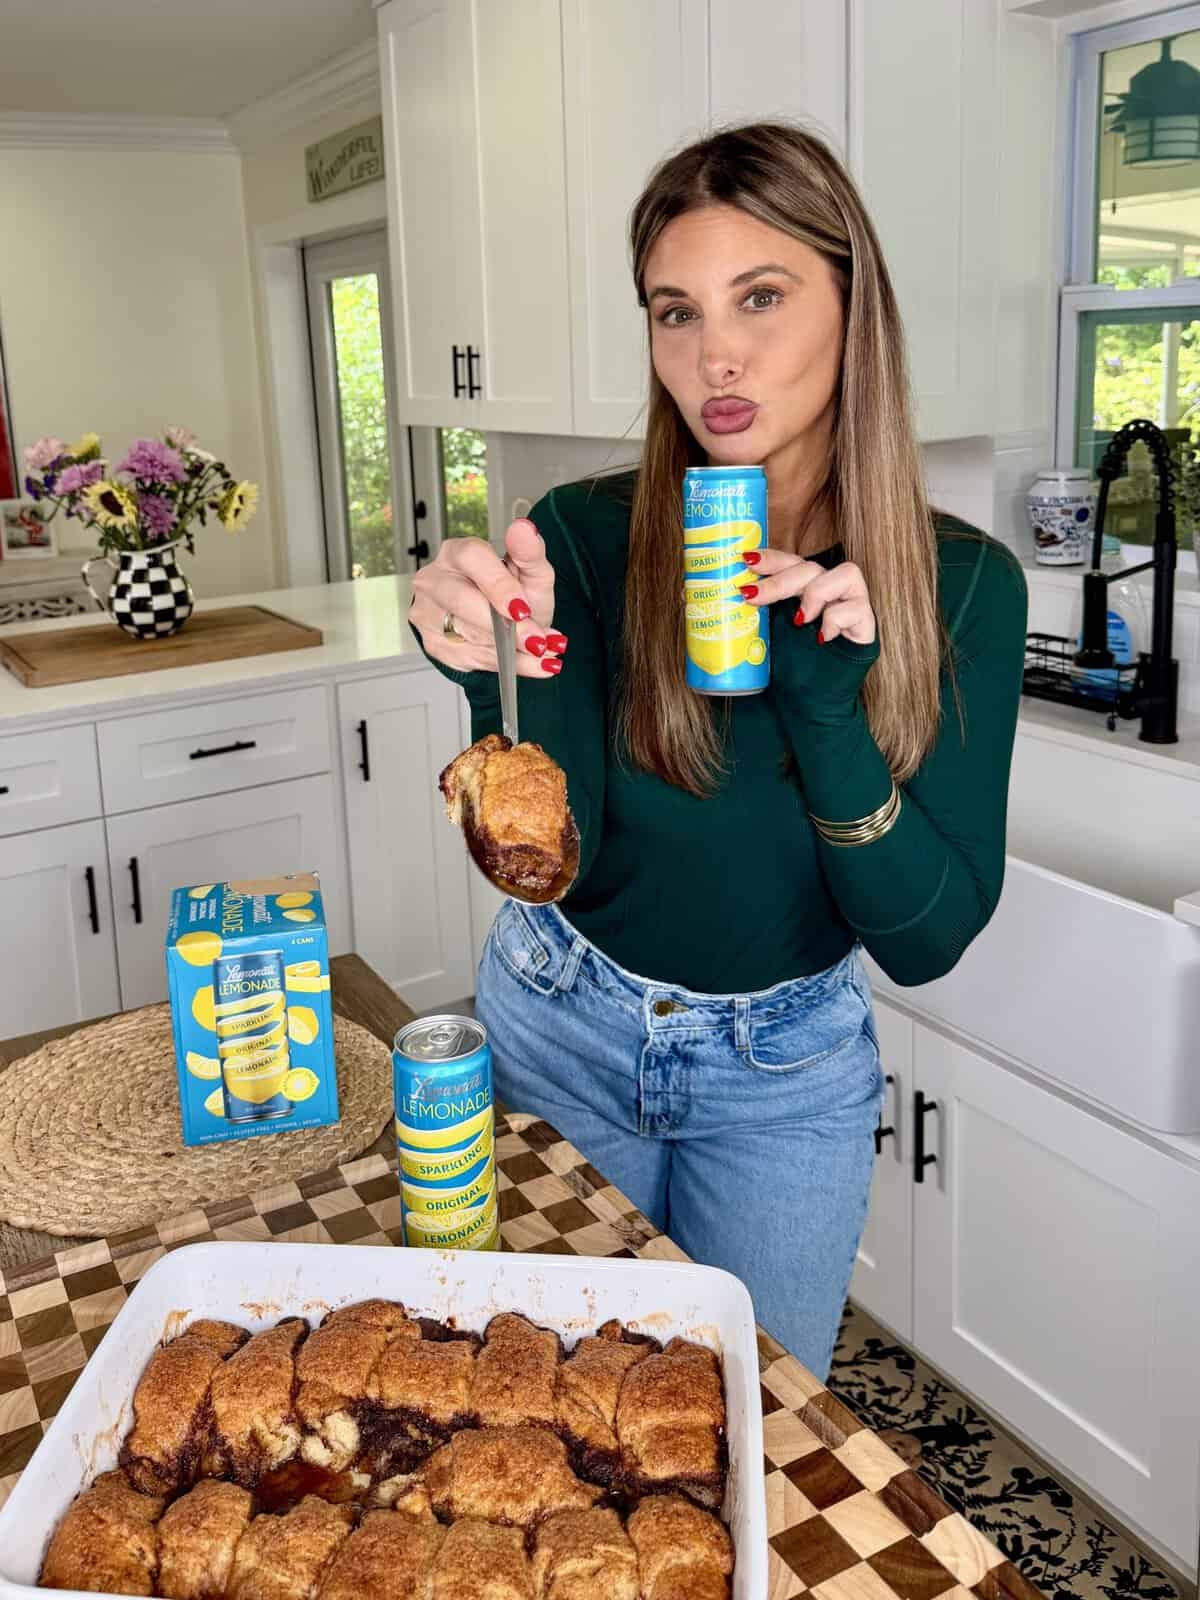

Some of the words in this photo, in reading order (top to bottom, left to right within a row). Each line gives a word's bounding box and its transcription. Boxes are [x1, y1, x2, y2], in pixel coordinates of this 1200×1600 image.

[685, 502, 754, 518] EMONADE
[219, 977, 280, 996] LEMONADE
[402, 1086, 490, 1120] LEMONADE
[419, 1145, 482, 1175] SPARKLING
[426, 1185, 482, 1211] ORIGINAL
[425, 1216, 485, 1243] LEMONADE
